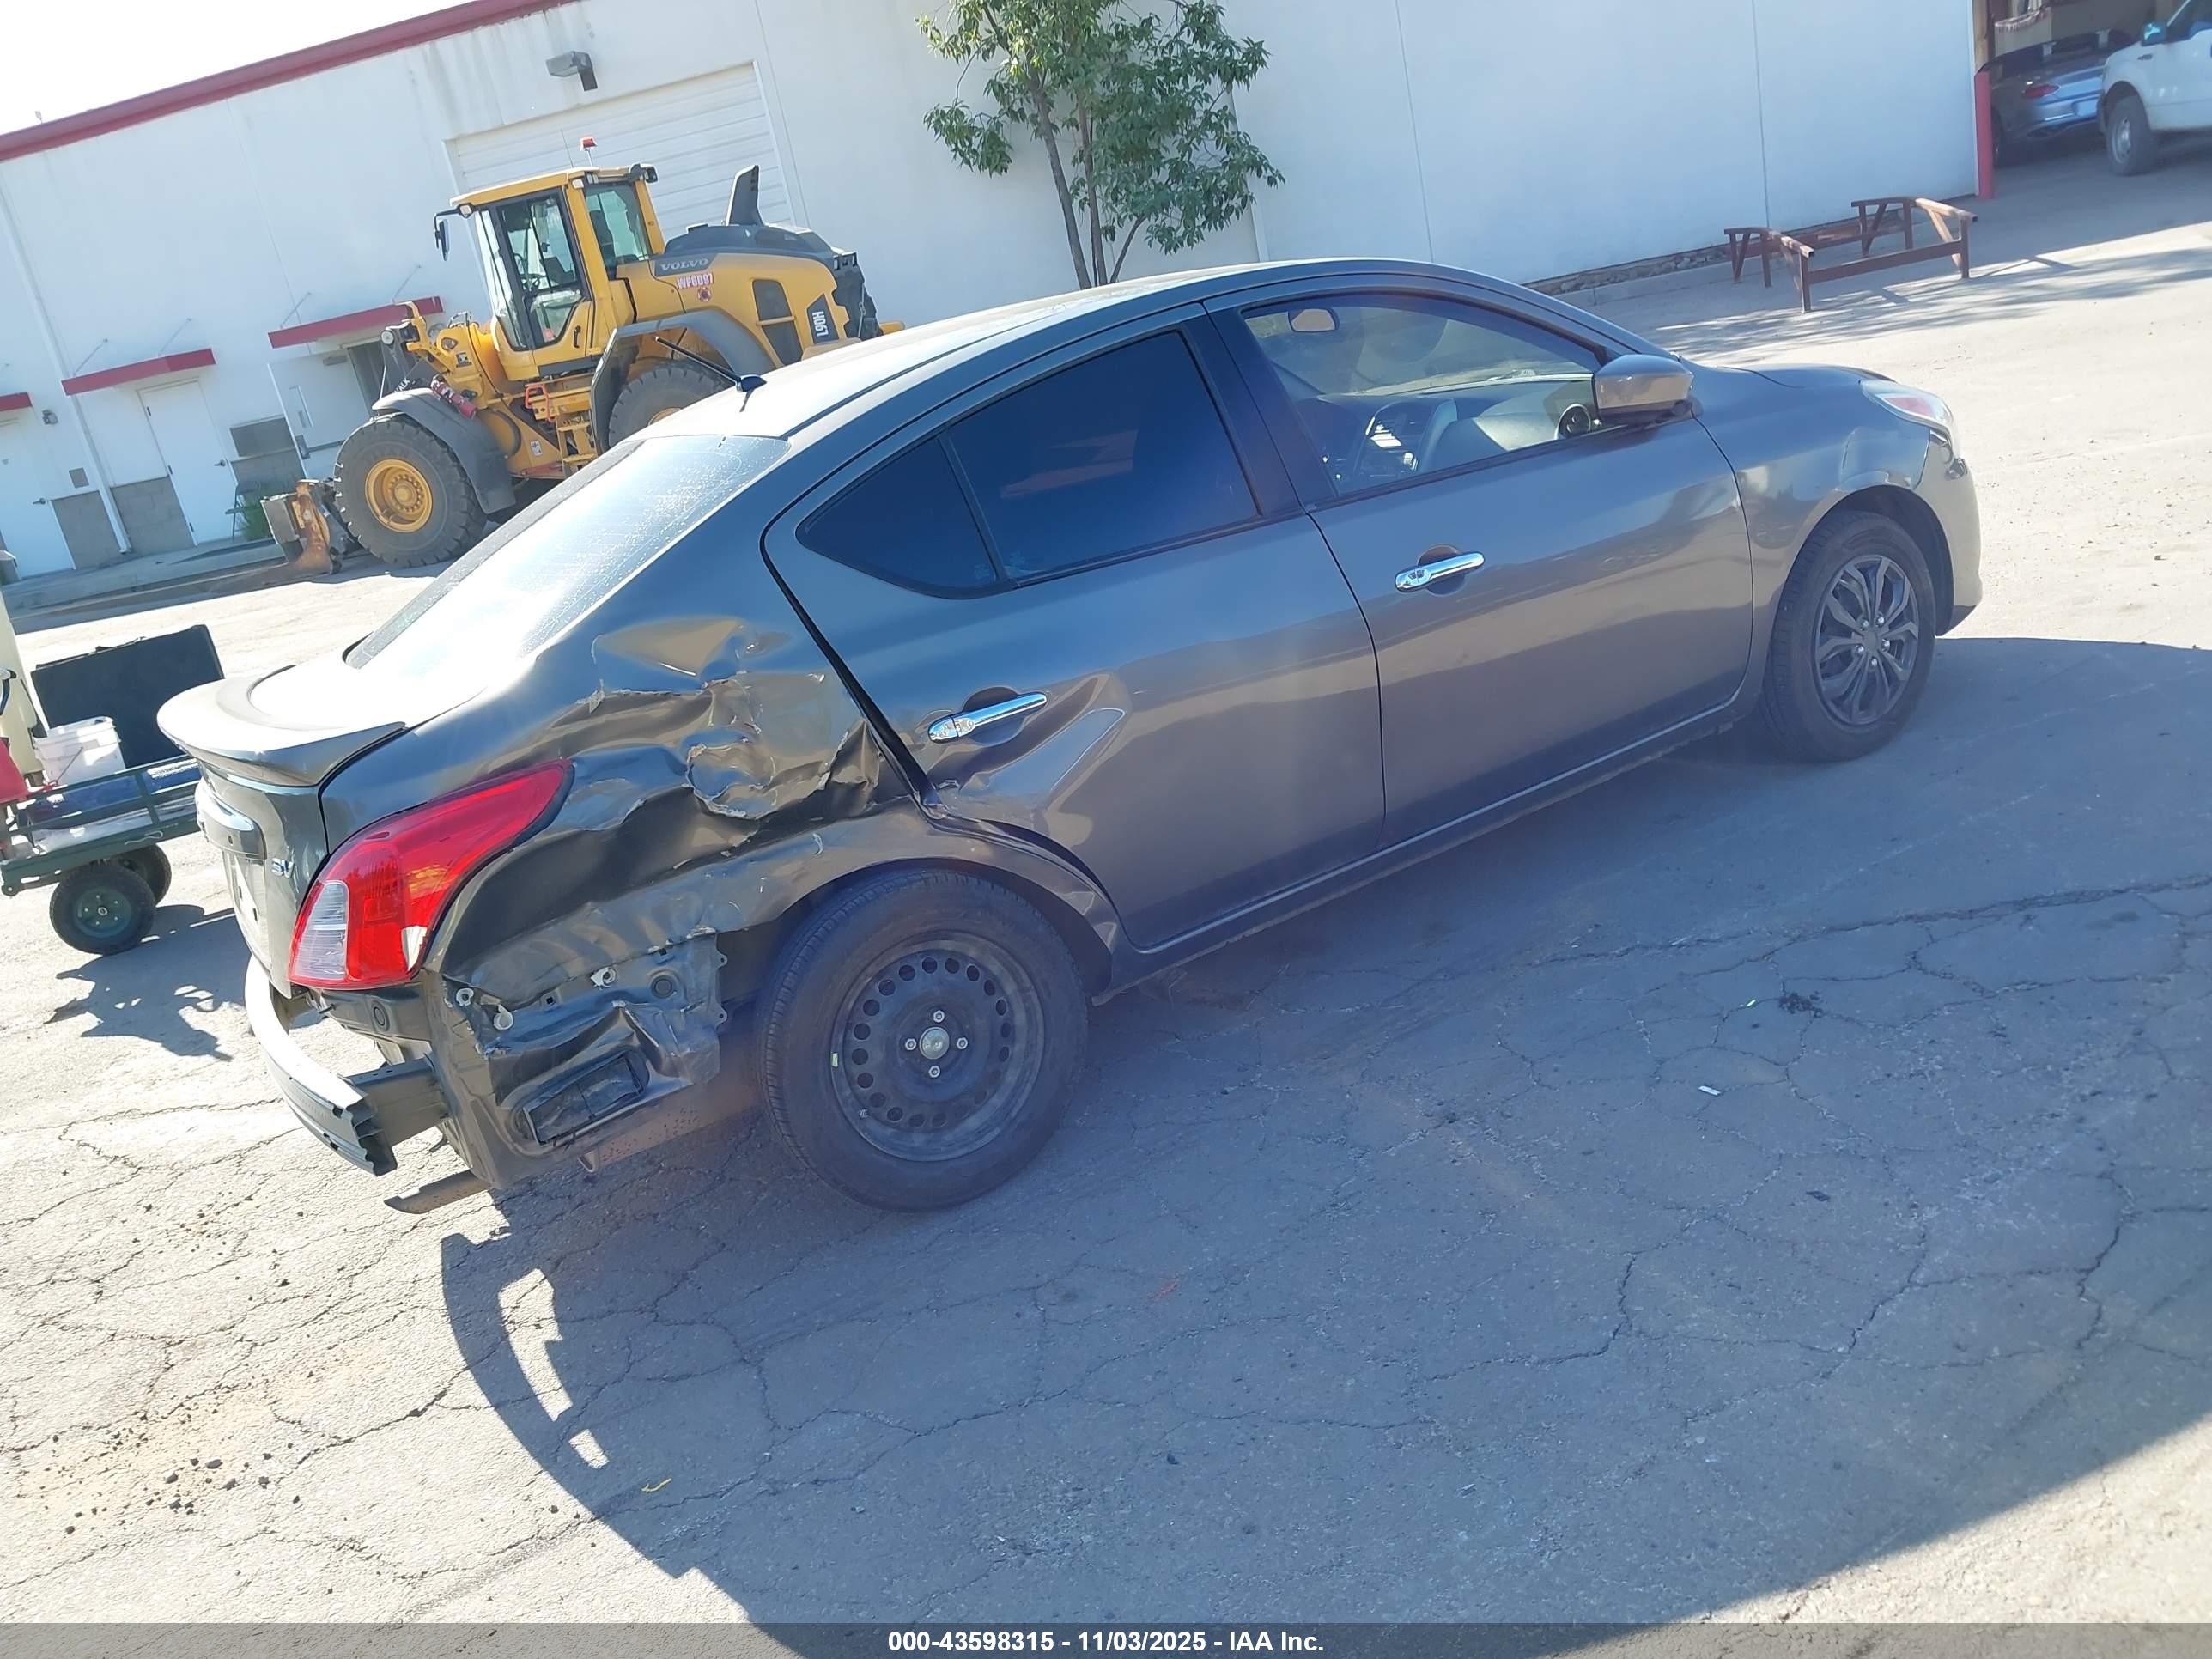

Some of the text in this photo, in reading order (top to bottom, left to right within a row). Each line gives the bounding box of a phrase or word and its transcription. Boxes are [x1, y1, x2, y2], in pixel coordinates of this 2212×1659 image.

[660, 258, 708, 271] VOLVO
[811, 310, 830, 337] L90H
[271, 858, 294, 878] SV
